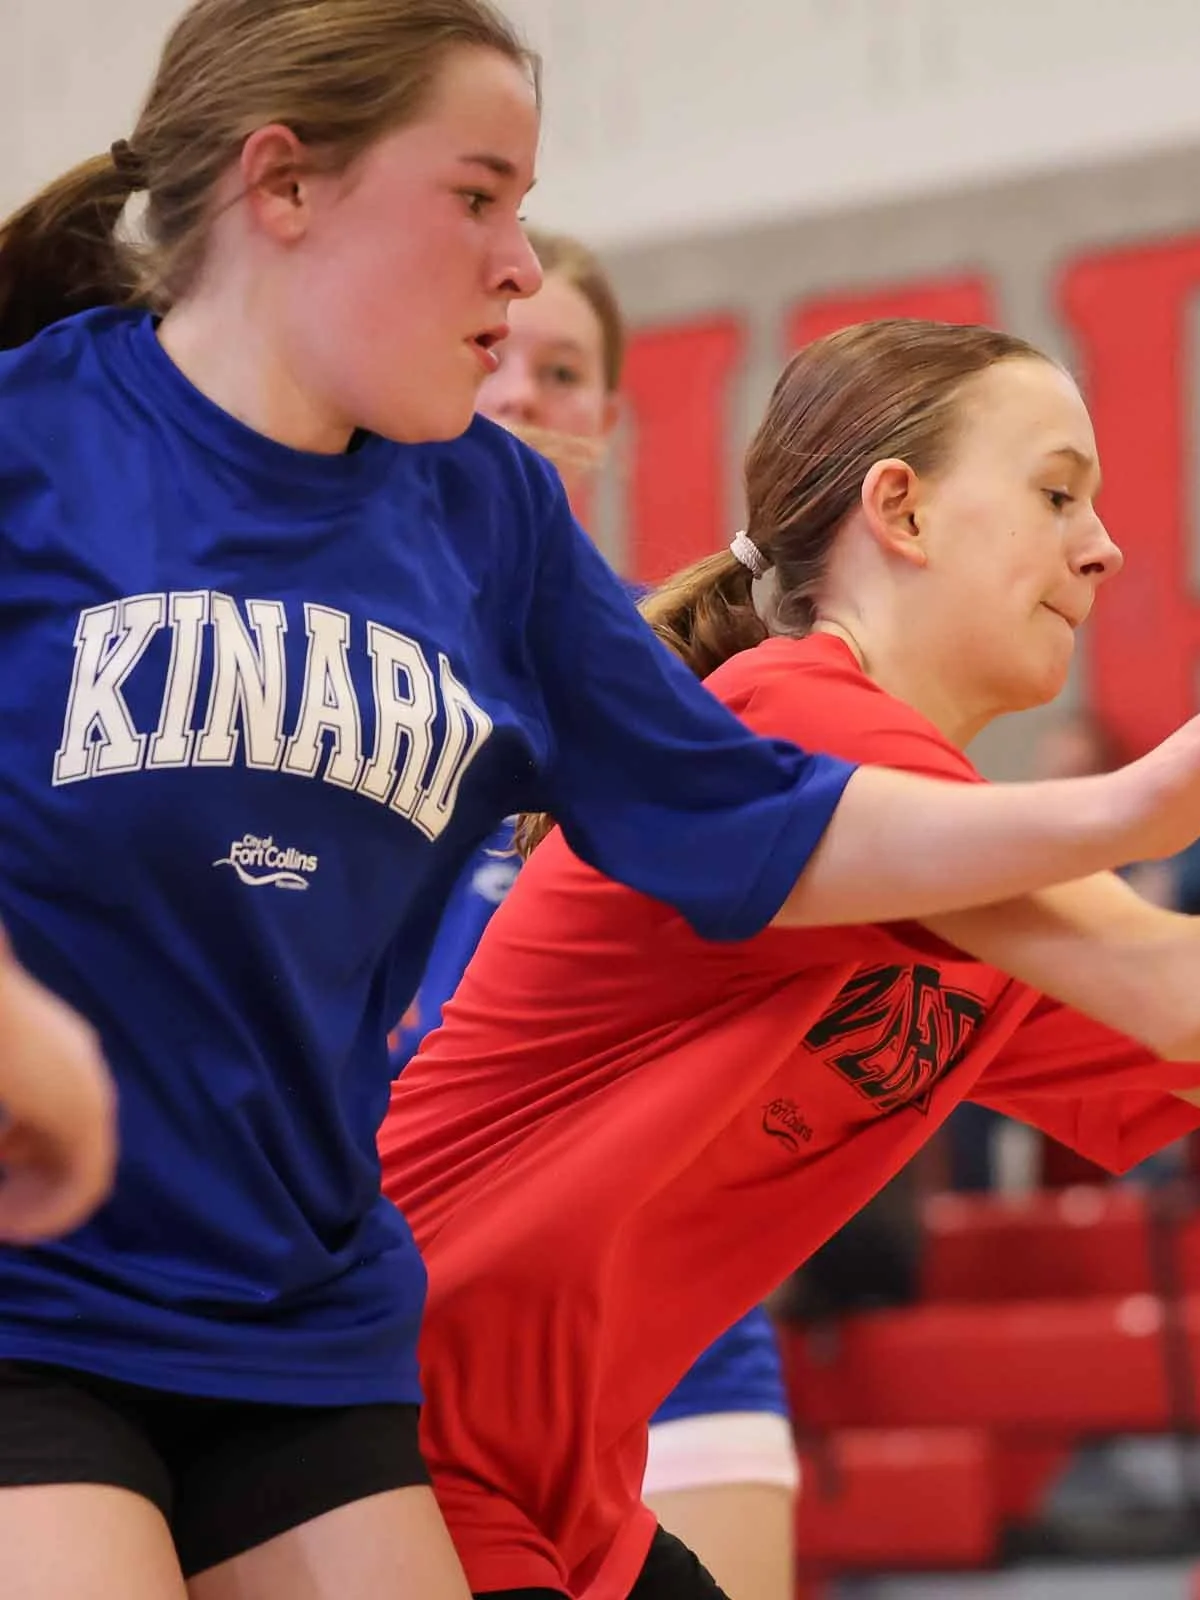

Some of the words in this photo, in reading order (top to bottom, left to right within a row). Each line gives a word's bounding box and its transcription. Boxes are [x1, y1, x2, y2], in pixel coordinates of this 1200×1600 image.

[52, 590, 493, 842] KINARD
[230, 841, 264, 867] Fort
[265, 846, 318, 872] Collins
